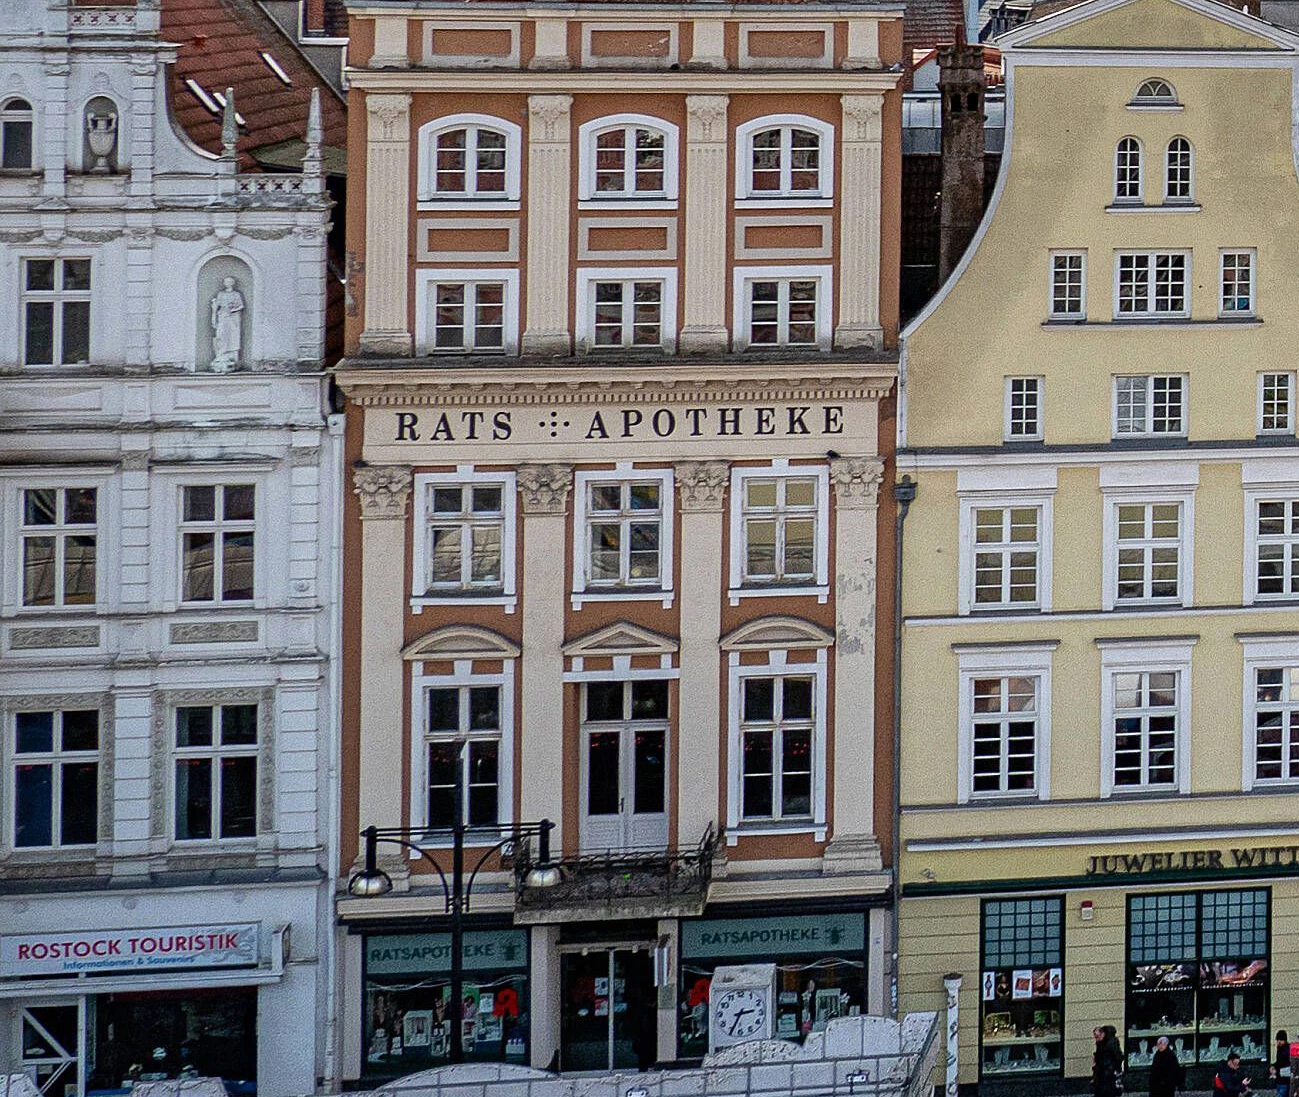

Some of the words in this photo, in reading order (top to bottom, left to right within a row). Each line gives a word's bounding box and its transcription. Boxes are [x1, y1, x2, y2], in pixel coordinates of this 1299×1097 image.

[395, 411, 513, 441] RATS
[585, 406, 845, 439] APOTHEKE
[1086, 850, 1224, 875] JUWELIER
[18, 939, 122, 960] ROSTOCK
[128, 932, 239, 954] TOURISTIK
[701, 928, 820, 945] RATSAPOTHEKE
[63, 959, 134, 971] Informationen
[147, 955, 197, 966] Souvenirs
[371, 944, 497, 962] RATSAPOTEKE
